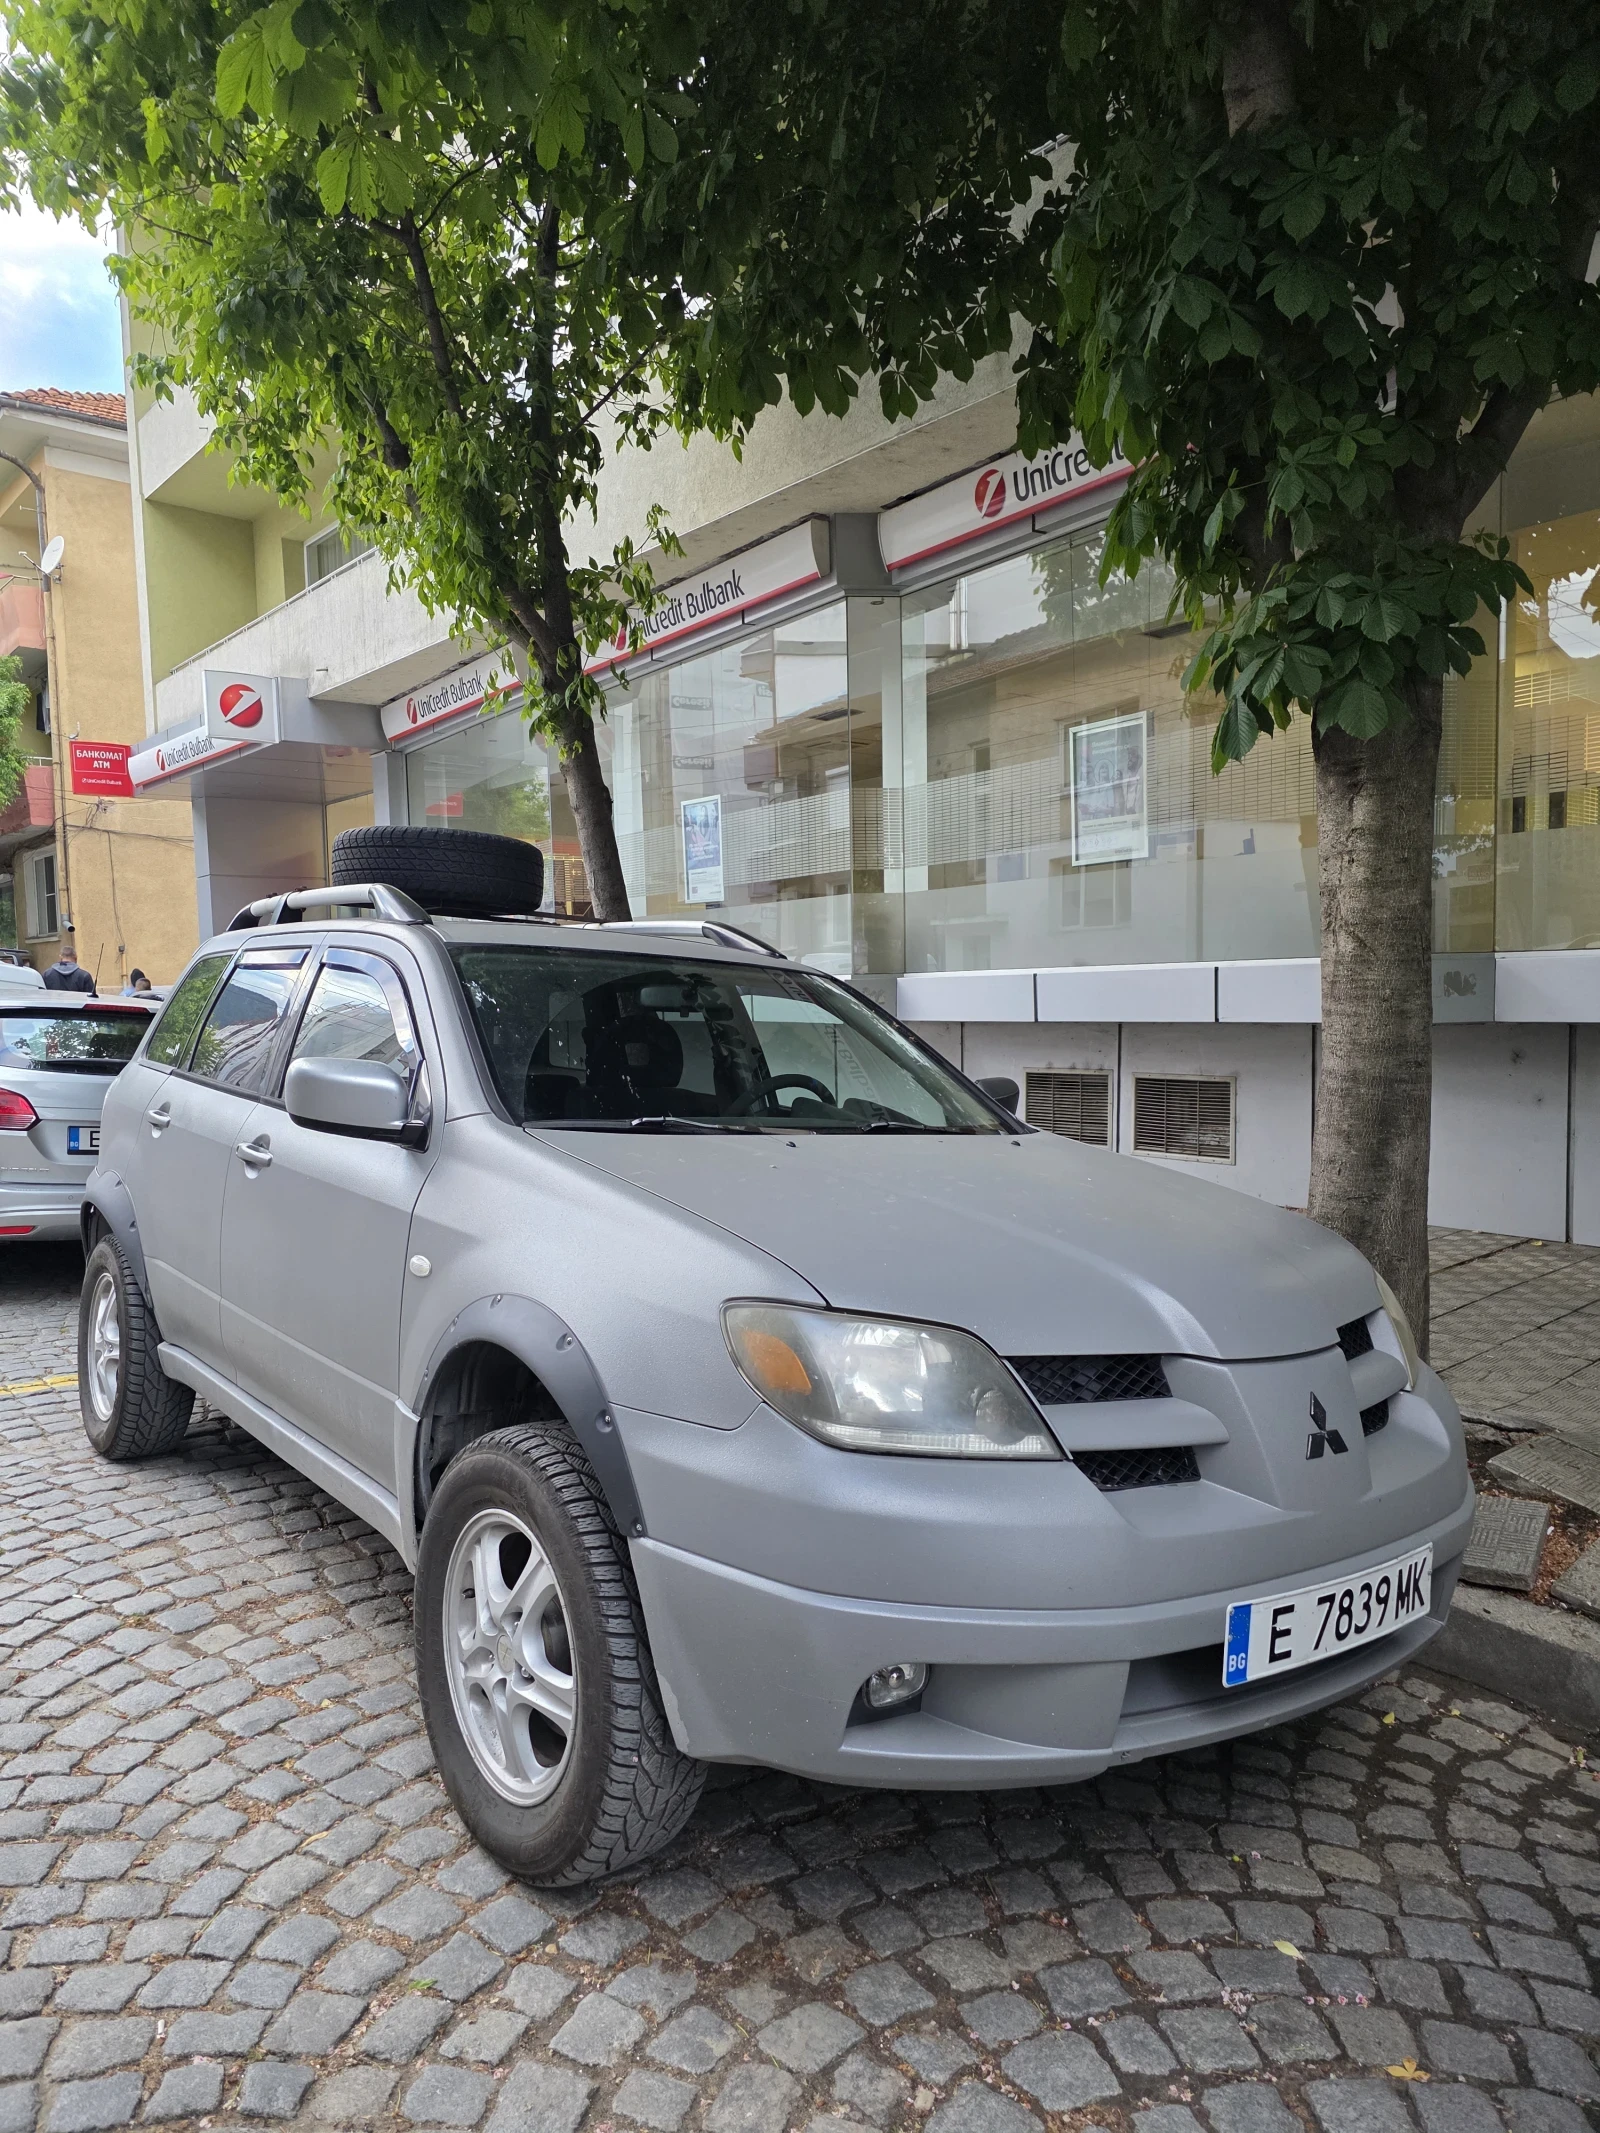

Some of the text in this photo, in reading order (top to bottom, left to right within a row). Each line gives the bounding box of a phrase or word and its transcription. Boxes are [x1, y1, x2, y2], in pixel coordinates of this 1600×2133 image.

[686, 569, 745, 618] Bulbank
[417, 670, 484, 718] UniCredit Bulbank
[76, 749, 123, 761] БАНКОМАТ
[93, 760, 111, 769] ATM
[164, 736, 216, 767] UniCredit Bulbank
[90, 1130, 101, 1148] E
[1268, 1557, 1427, 1664] E 7839 MK
[1228, 1651, 1246, 1673] BG
